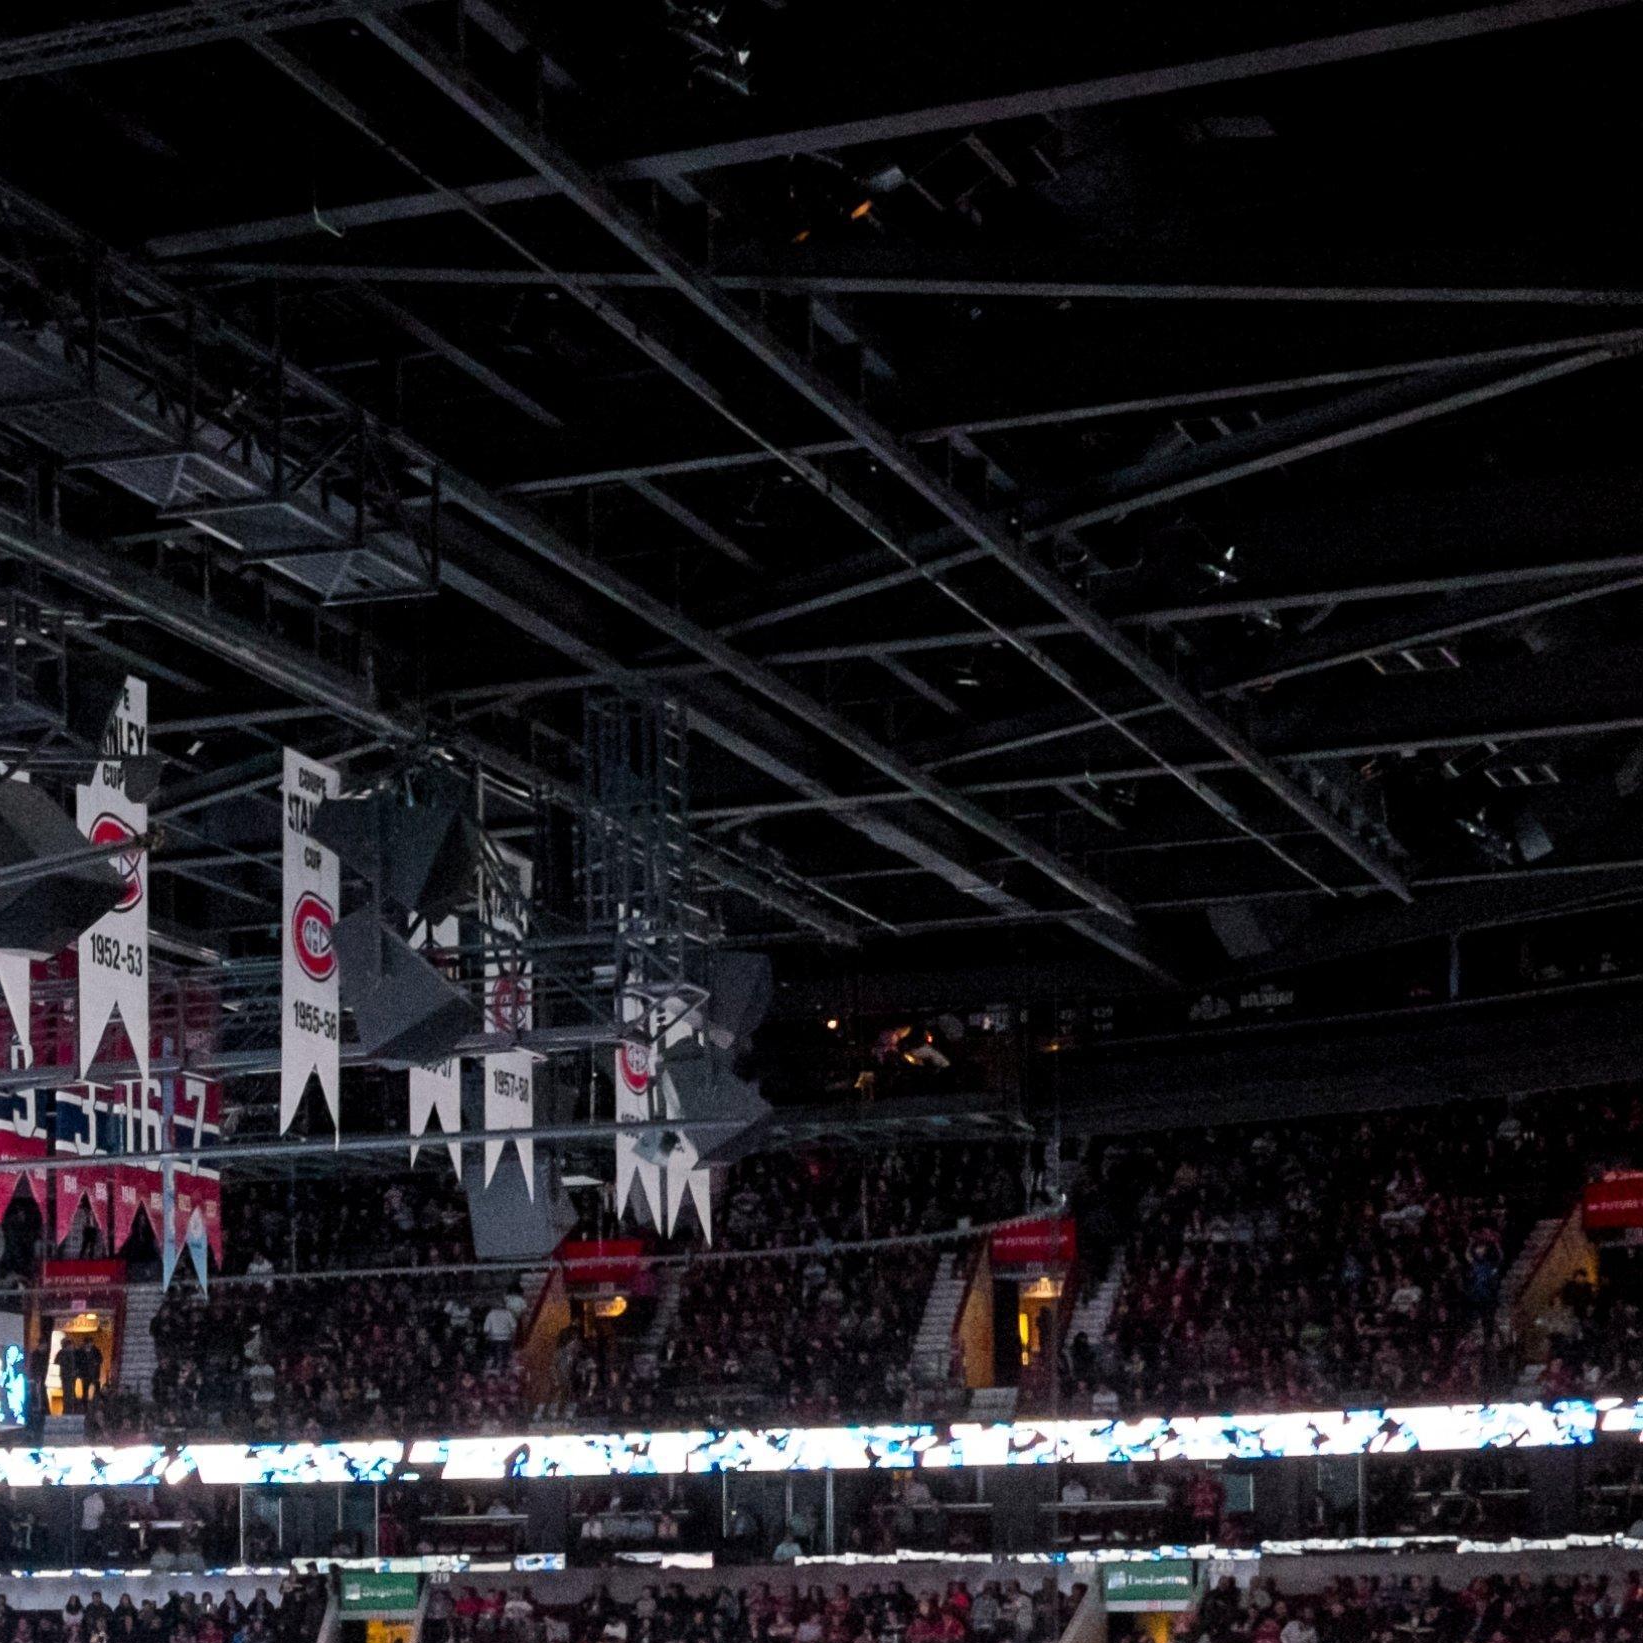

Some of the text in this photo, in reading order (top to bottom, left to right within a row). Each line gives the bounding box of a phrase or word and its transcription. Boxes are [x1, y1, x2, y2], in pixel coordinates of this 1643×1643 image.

[304, 847, 322, 870] CUP
[90, 932, 143, 977] 1952-53
[293, 1000, 337, 1040] 1955-56
[186, 1078, 207, 1175] 7
